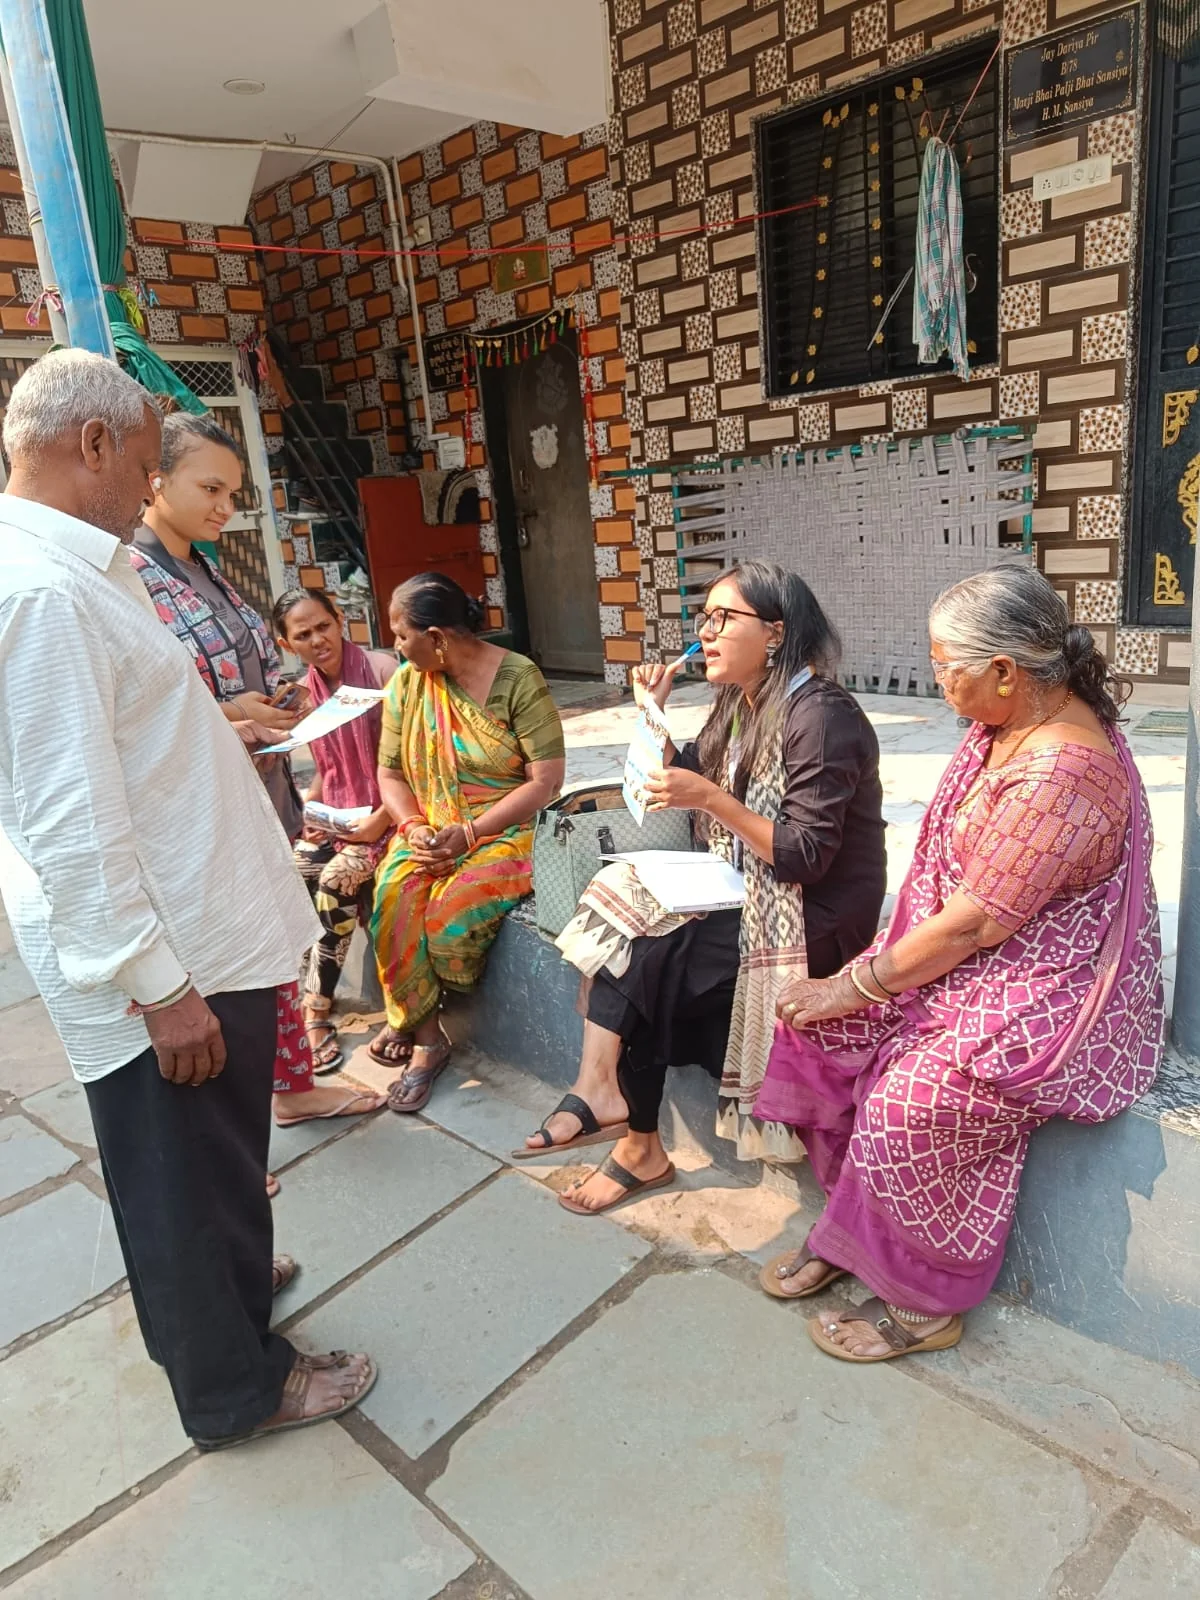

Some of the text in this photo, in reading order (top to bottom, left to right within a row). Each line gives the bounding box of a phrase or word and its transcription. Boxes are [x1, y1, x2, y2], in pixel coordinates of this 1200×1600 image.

[1041, 31, 1099, 62] Jay Dariya Pir
[1035, 86, 1053, 103] Bhai
[1075, 73, 1095, 91] Bhai
[1042, 107, 1051, 121] H.
[1052, 103, 1062, 118] M.
